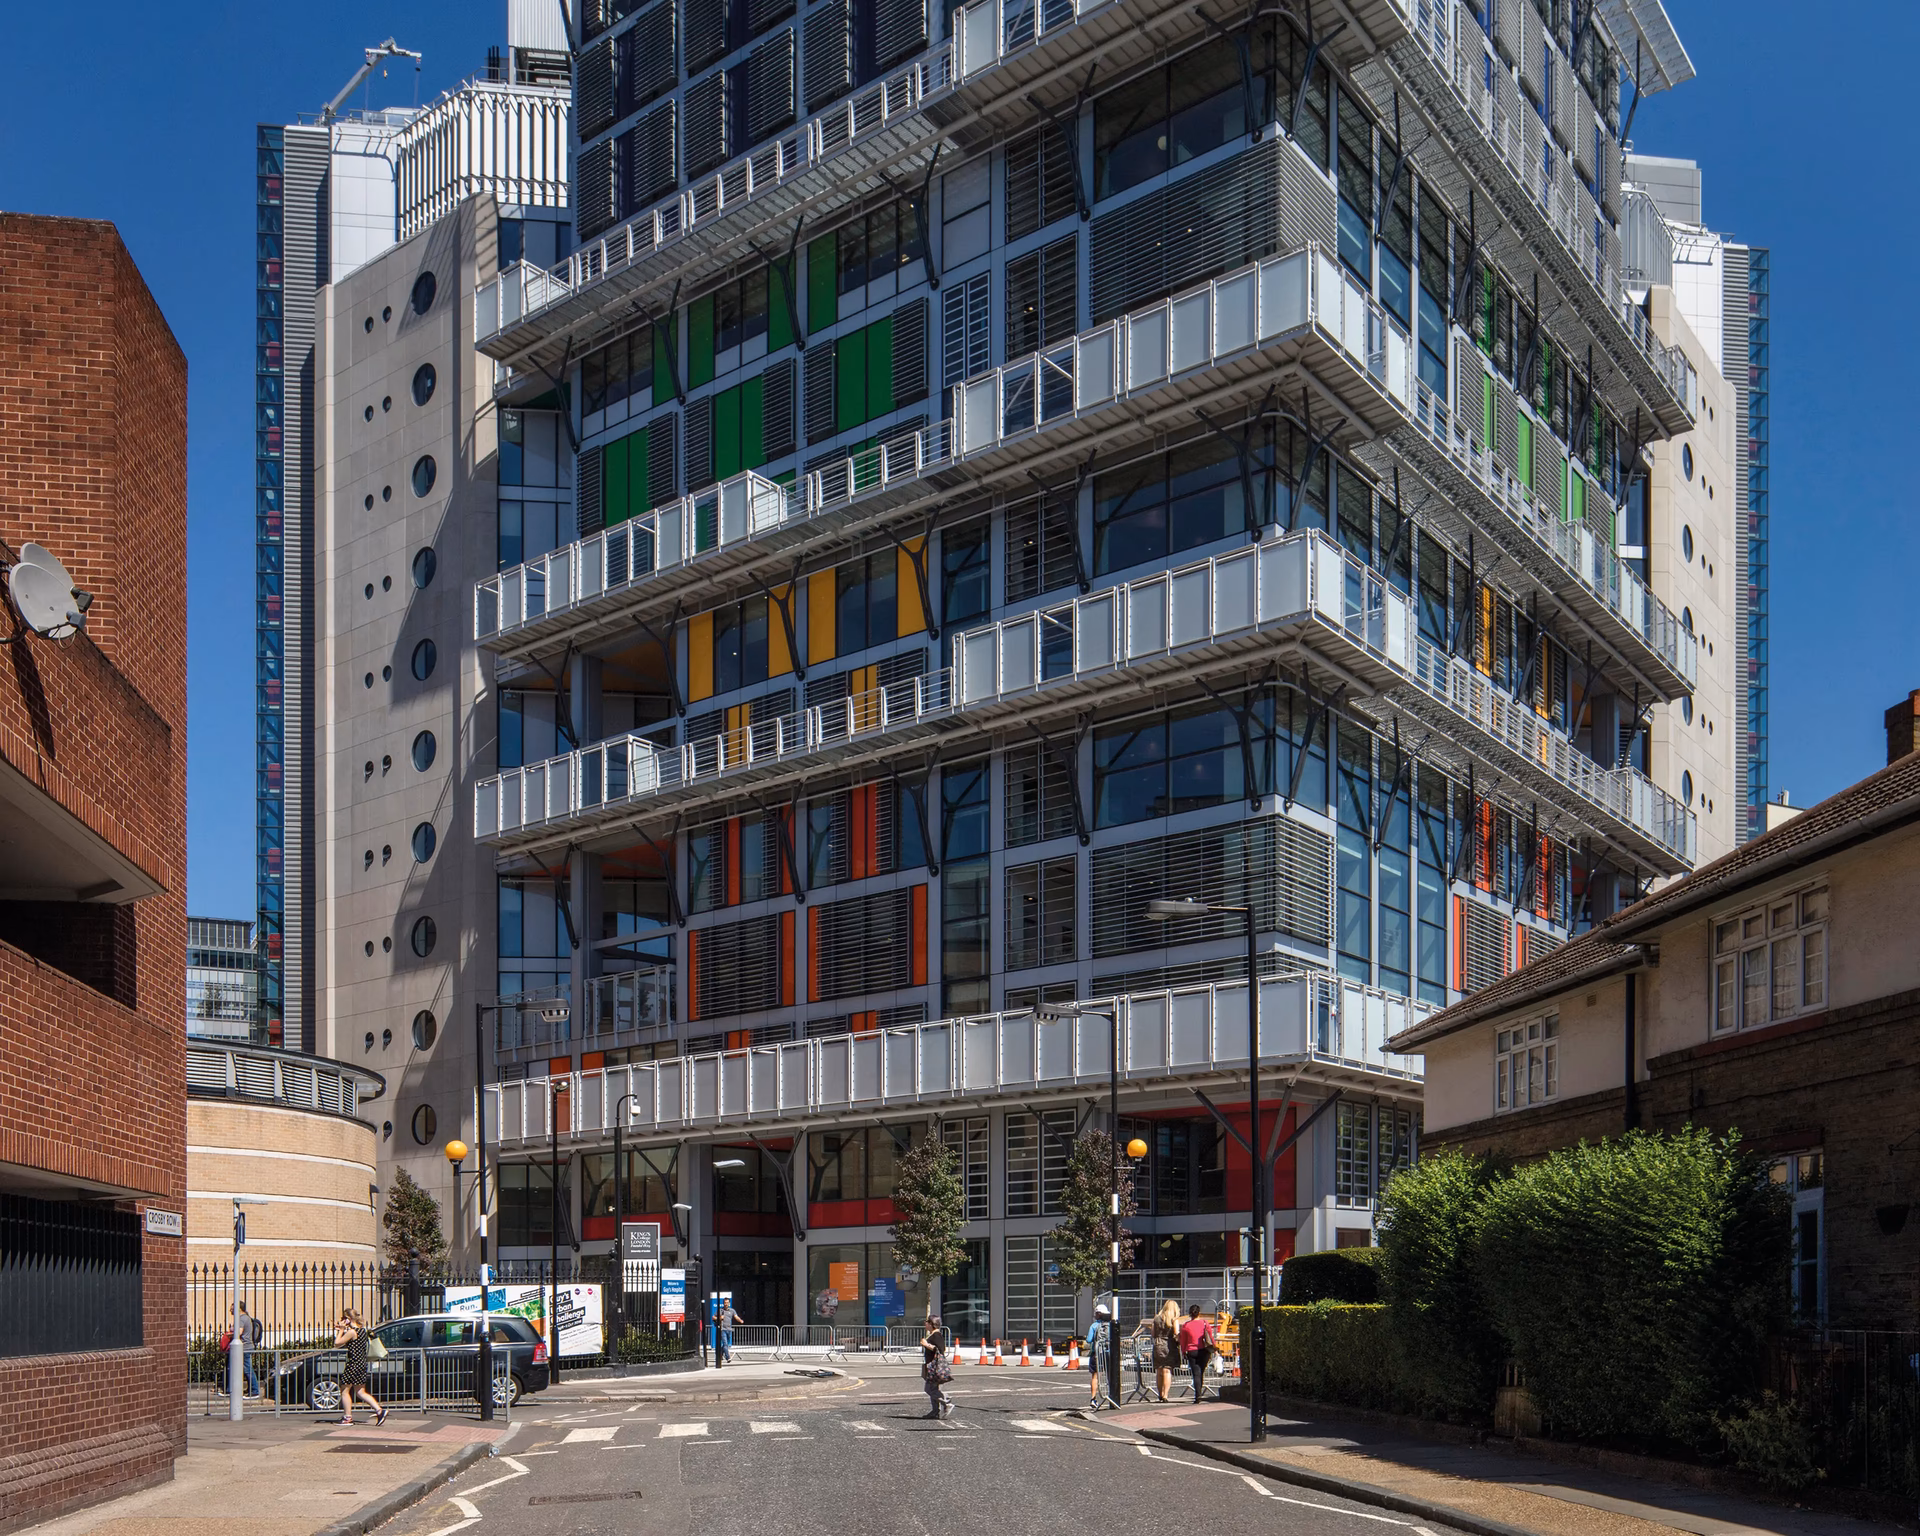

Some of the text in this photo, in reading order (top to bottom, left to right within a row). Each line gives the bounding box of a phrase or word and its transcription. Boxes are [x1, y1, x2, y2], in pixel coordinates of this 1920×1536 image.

[149, 1211, 166, 1224] CROSBY
[166, 1214, 178, 1226] ROW
[630, 1231, 651, 1240] KING'S
[460, 1303, 478, 1311] Run.
